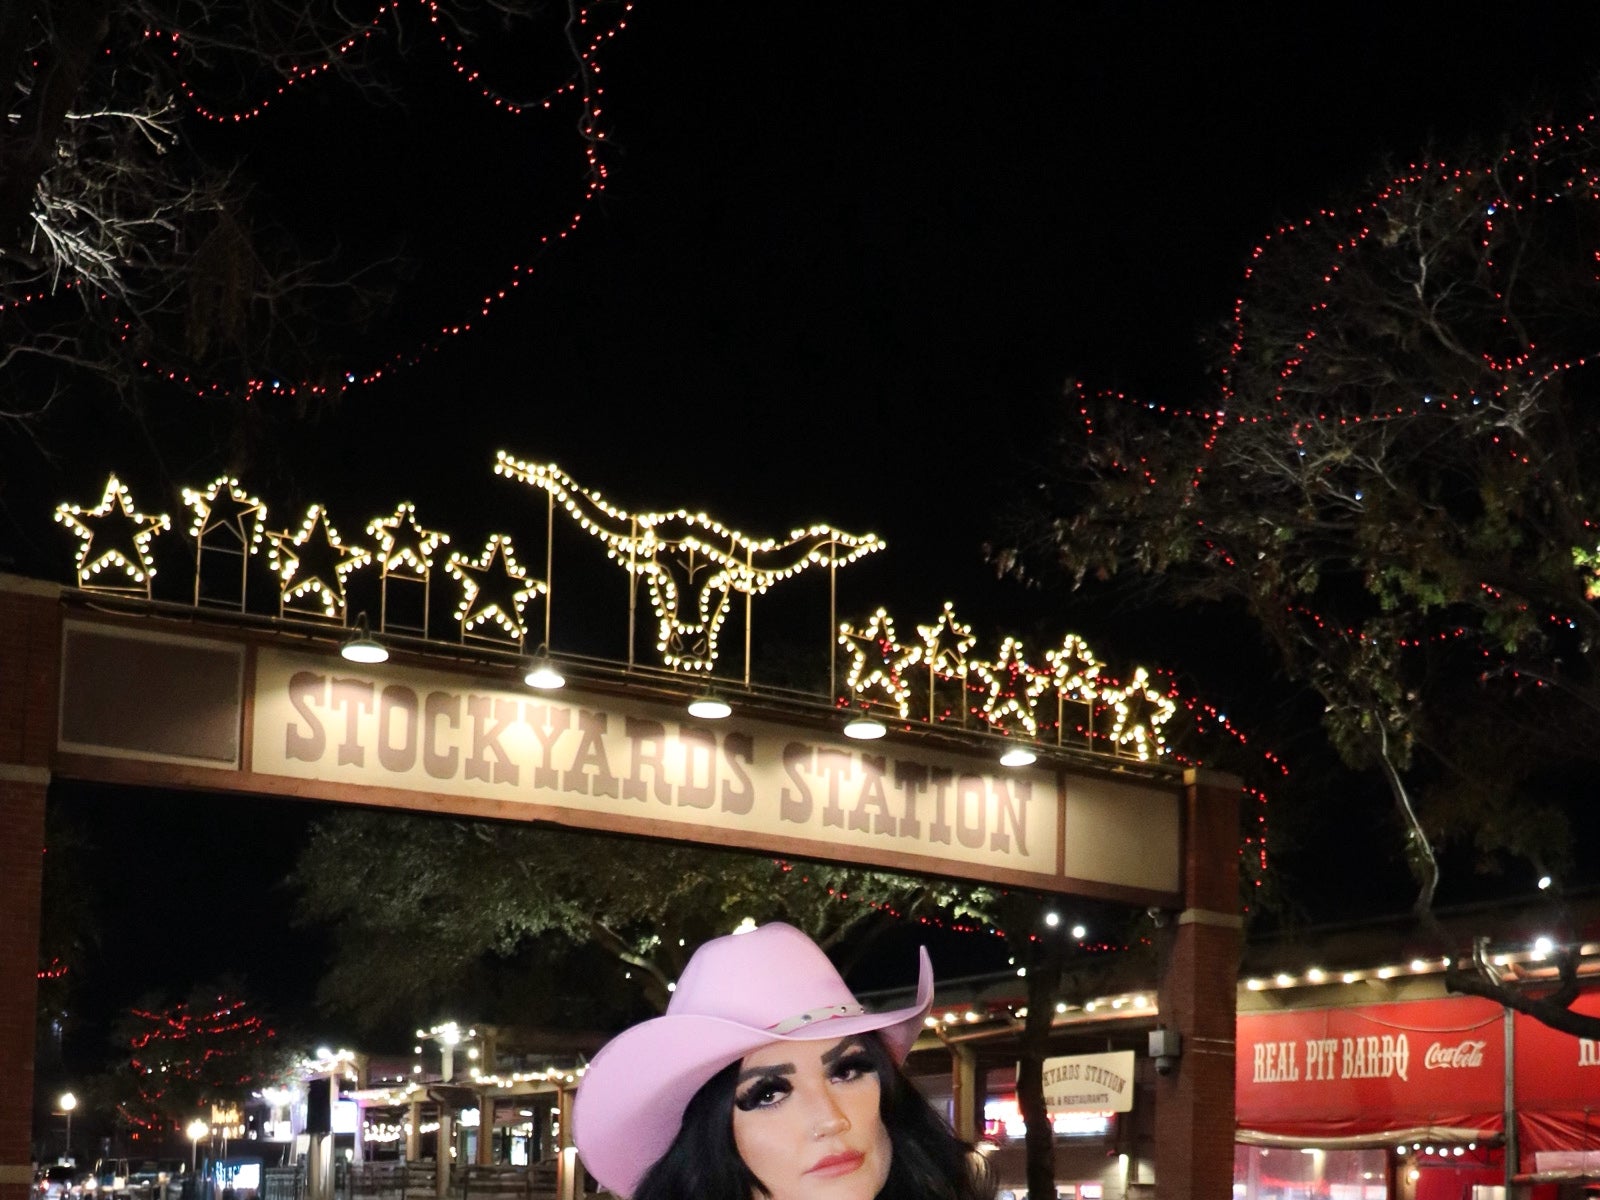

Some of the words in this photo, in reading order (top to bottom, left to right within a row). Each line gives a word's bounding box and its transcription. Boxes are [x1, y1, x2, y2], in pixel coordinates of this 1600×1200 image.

[285, 671, 755, 816] STOCKYARDS
[779, 740, 1032, 857] STATION
[1043, 1064, 1080, 1087] KYARDS
[1085, 1064, 1126, 1094] STATION
[1253, 1041, 1299, 1083] REAL
[1305, 1038, 1338, 1081] PIT
